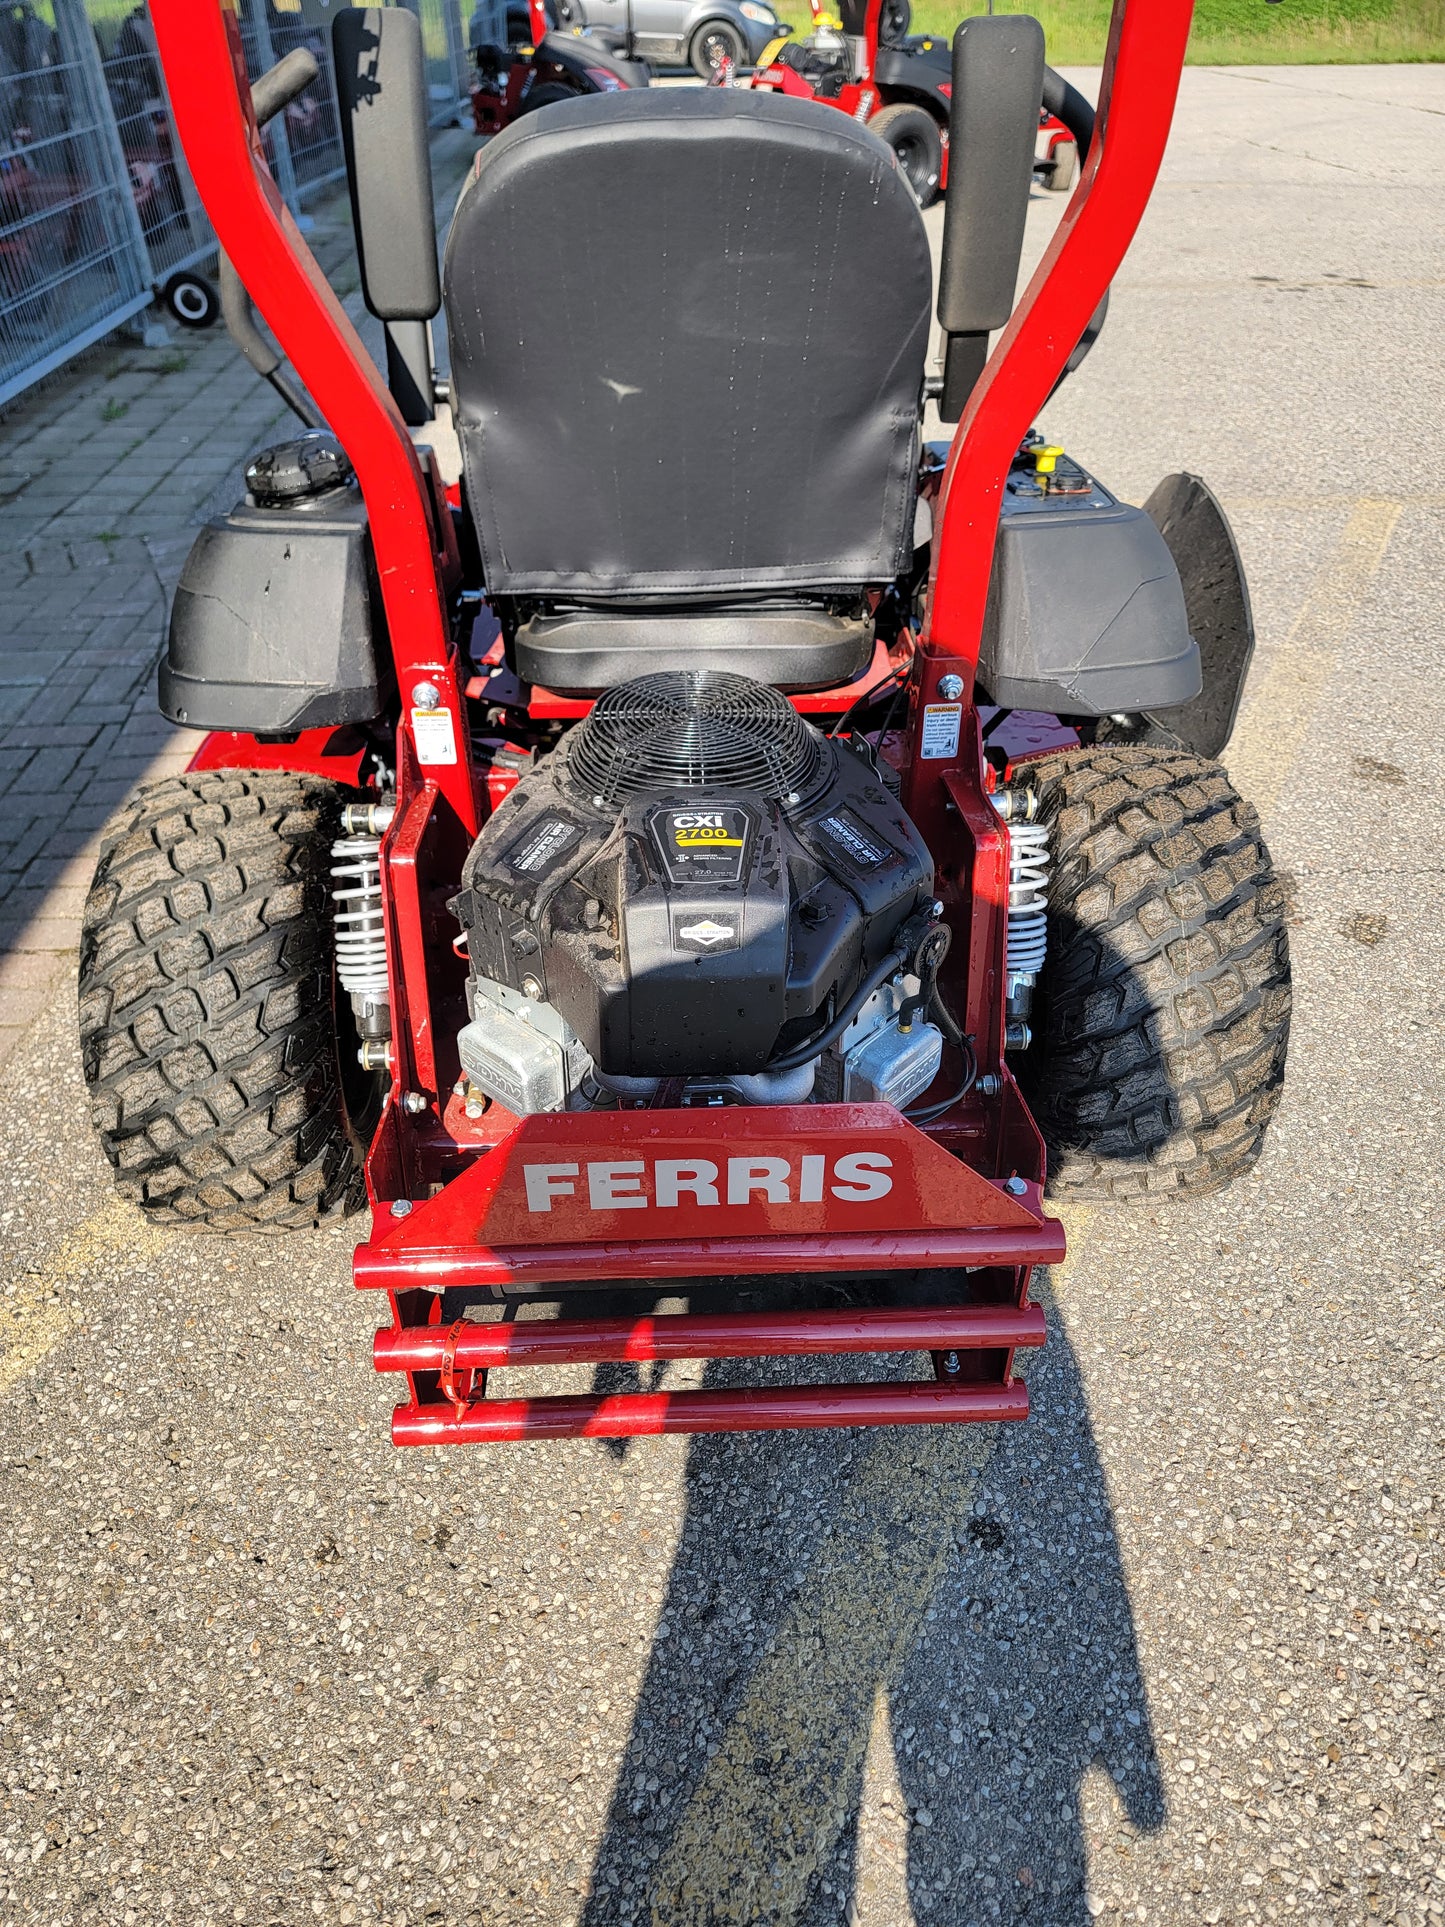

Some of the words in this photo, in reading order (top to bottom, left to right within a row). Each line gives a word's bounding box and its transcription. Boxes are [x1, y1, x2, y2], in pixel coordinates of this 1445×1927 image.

[550, 822, 565, 835] AIR
[674, 828, 728, 839] 2700
[818, 820, 869, 864] CYCLONIC
[827, 817, 864, 848] CLEANER
[518, 836, 554, 870] CLEANER
[528, 825, 575, 871] CYCLONIC
[861, 849, 879, 861] AIR
[523, 1152, 893, 1212] FERRIS
